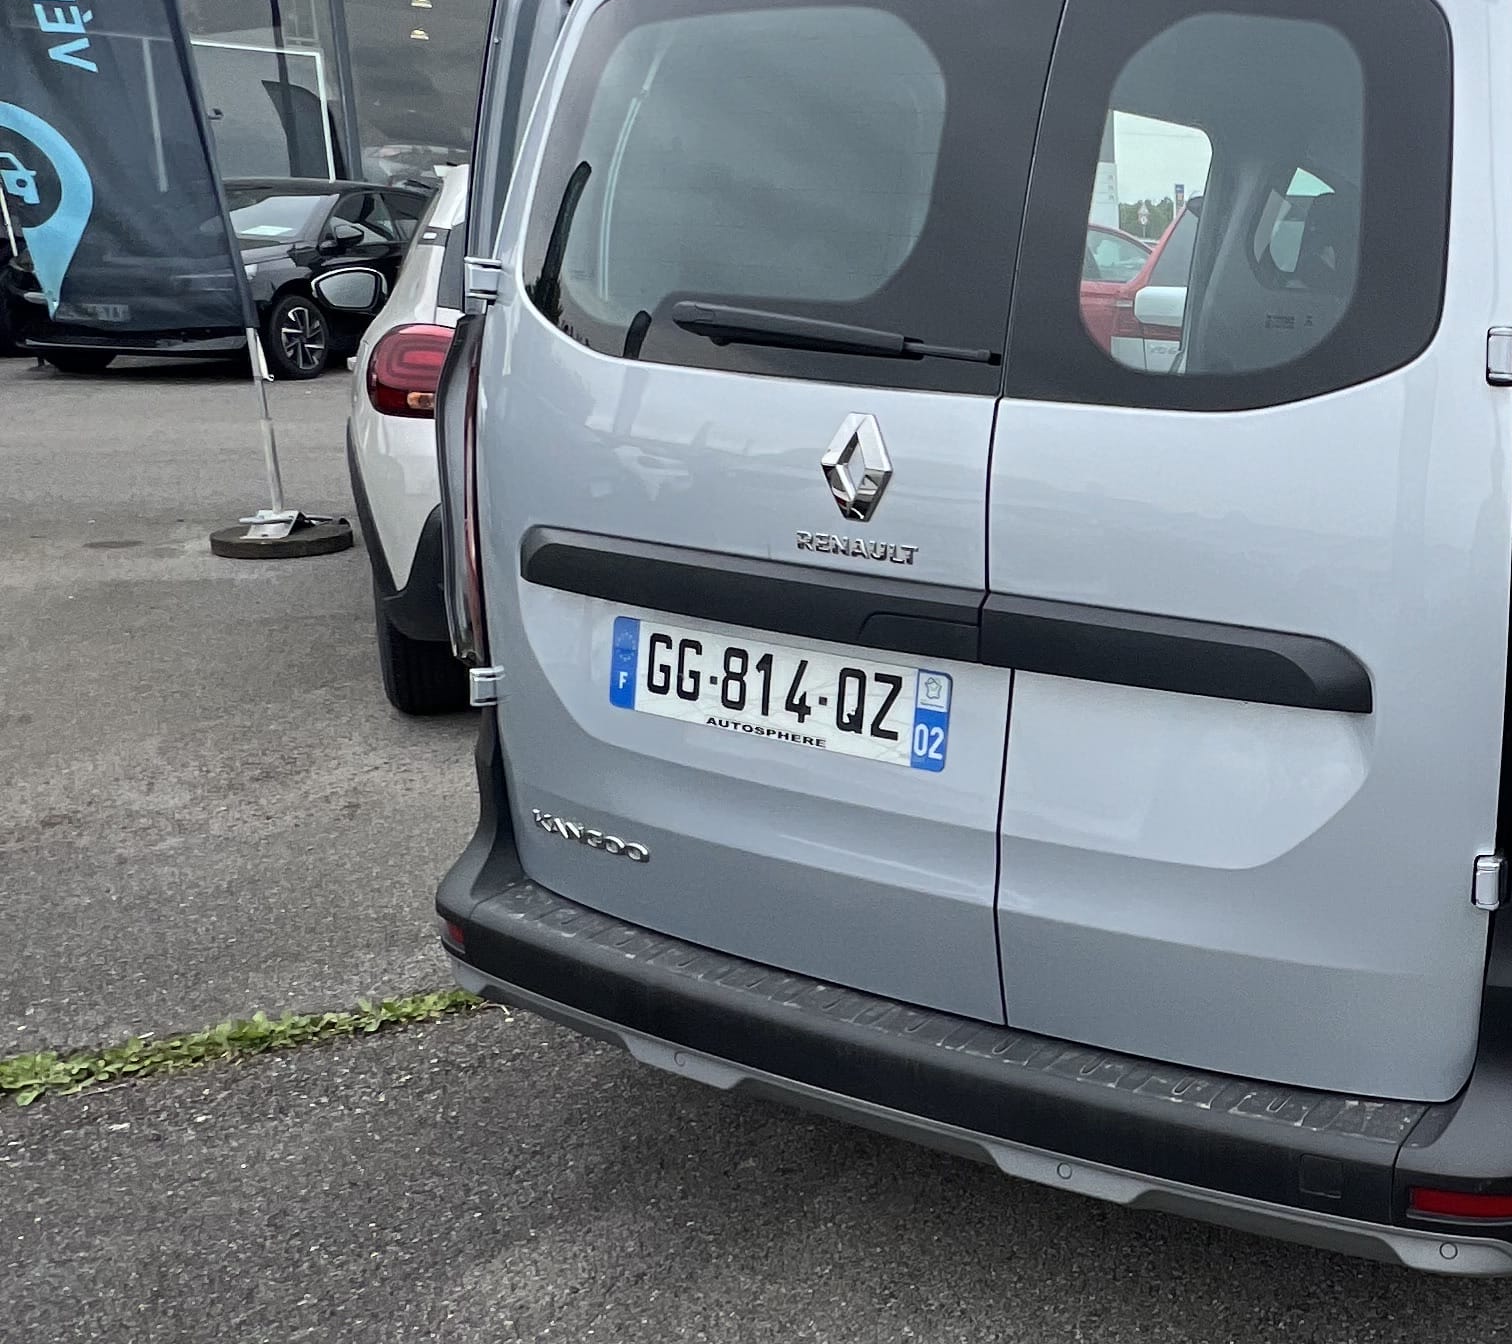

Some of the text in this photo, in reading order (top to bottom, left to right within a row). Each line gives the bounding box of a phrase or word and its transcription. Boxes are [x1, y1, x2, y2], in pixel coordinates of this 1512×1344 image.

[796, 530, 919, 565] RENAULT
[618, 632, 945, 761] F GG-814-QZ 02
[706, 717, 827, 748] AUTOSPHERE
[532, 808, 650, 863] KANGOO
